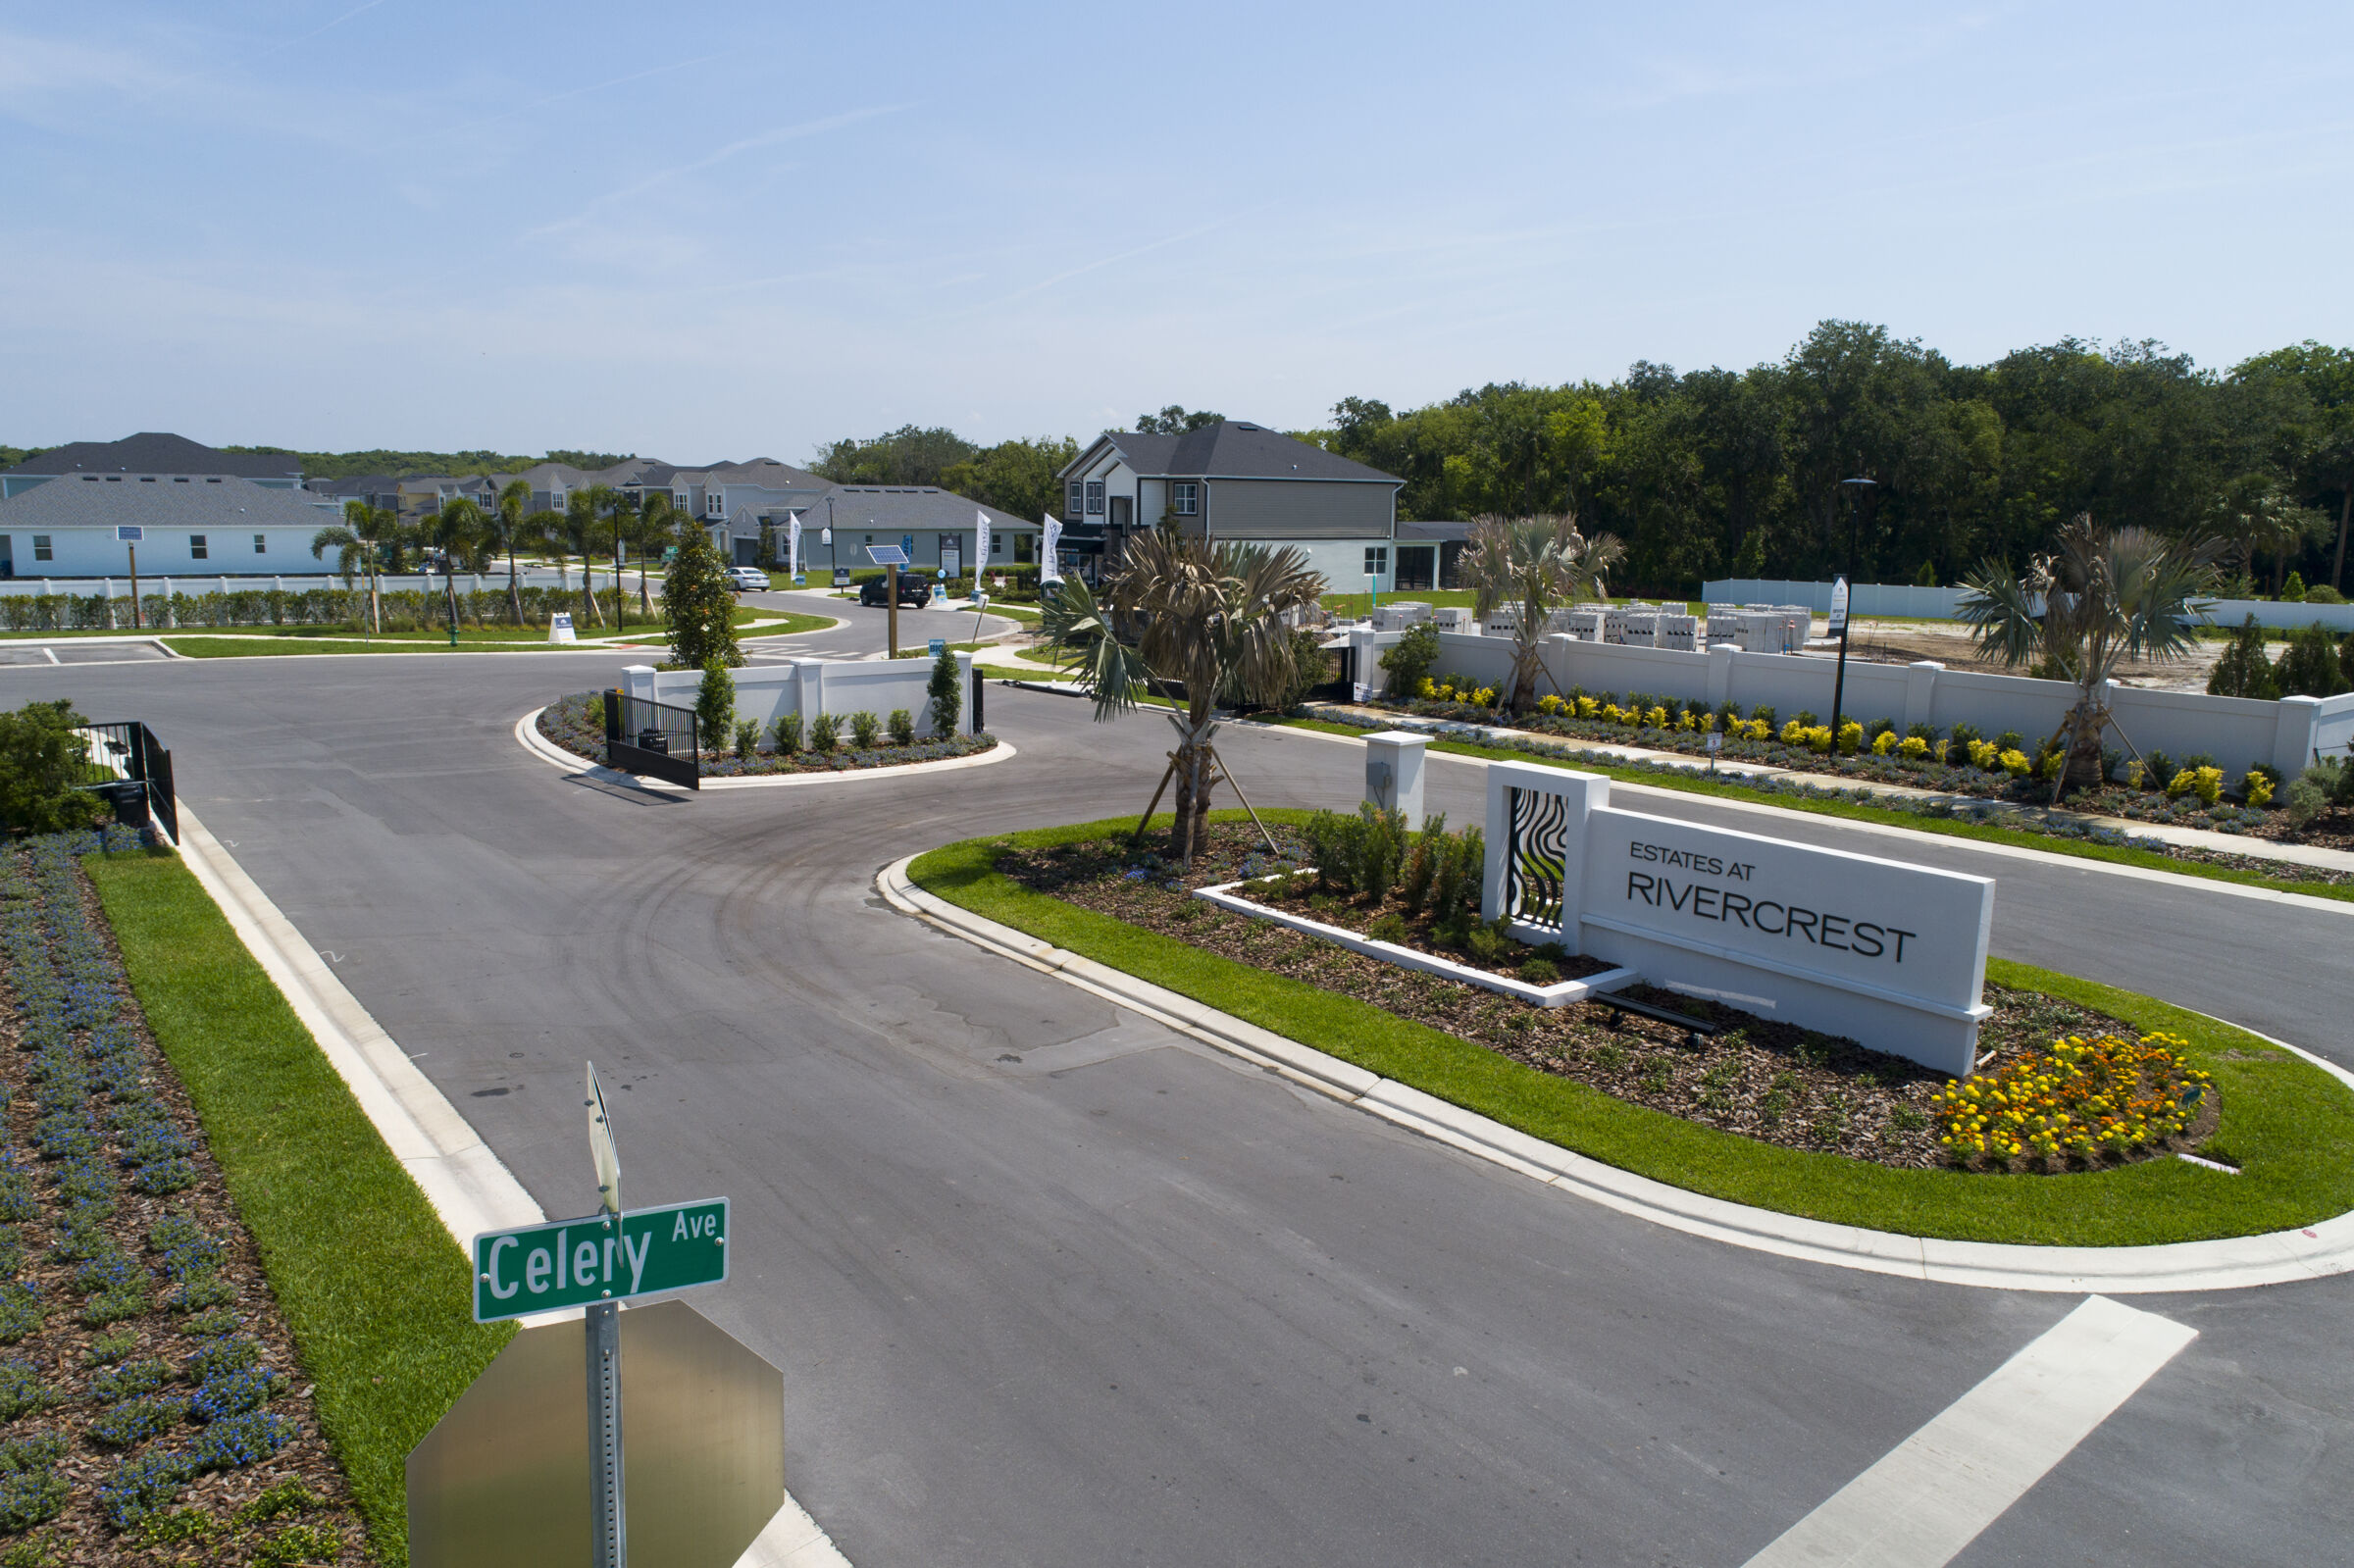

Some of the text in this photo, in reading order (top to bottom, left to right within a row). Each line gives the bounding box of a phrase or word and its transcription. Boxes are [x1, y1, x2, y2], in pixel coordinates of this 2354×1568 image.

[1629, 840, 1756, 882] ESTATES AT
[1626, 871, 1918, 964] RIVERCREST
[487, 1210, 717, 1300] Celery Ave
